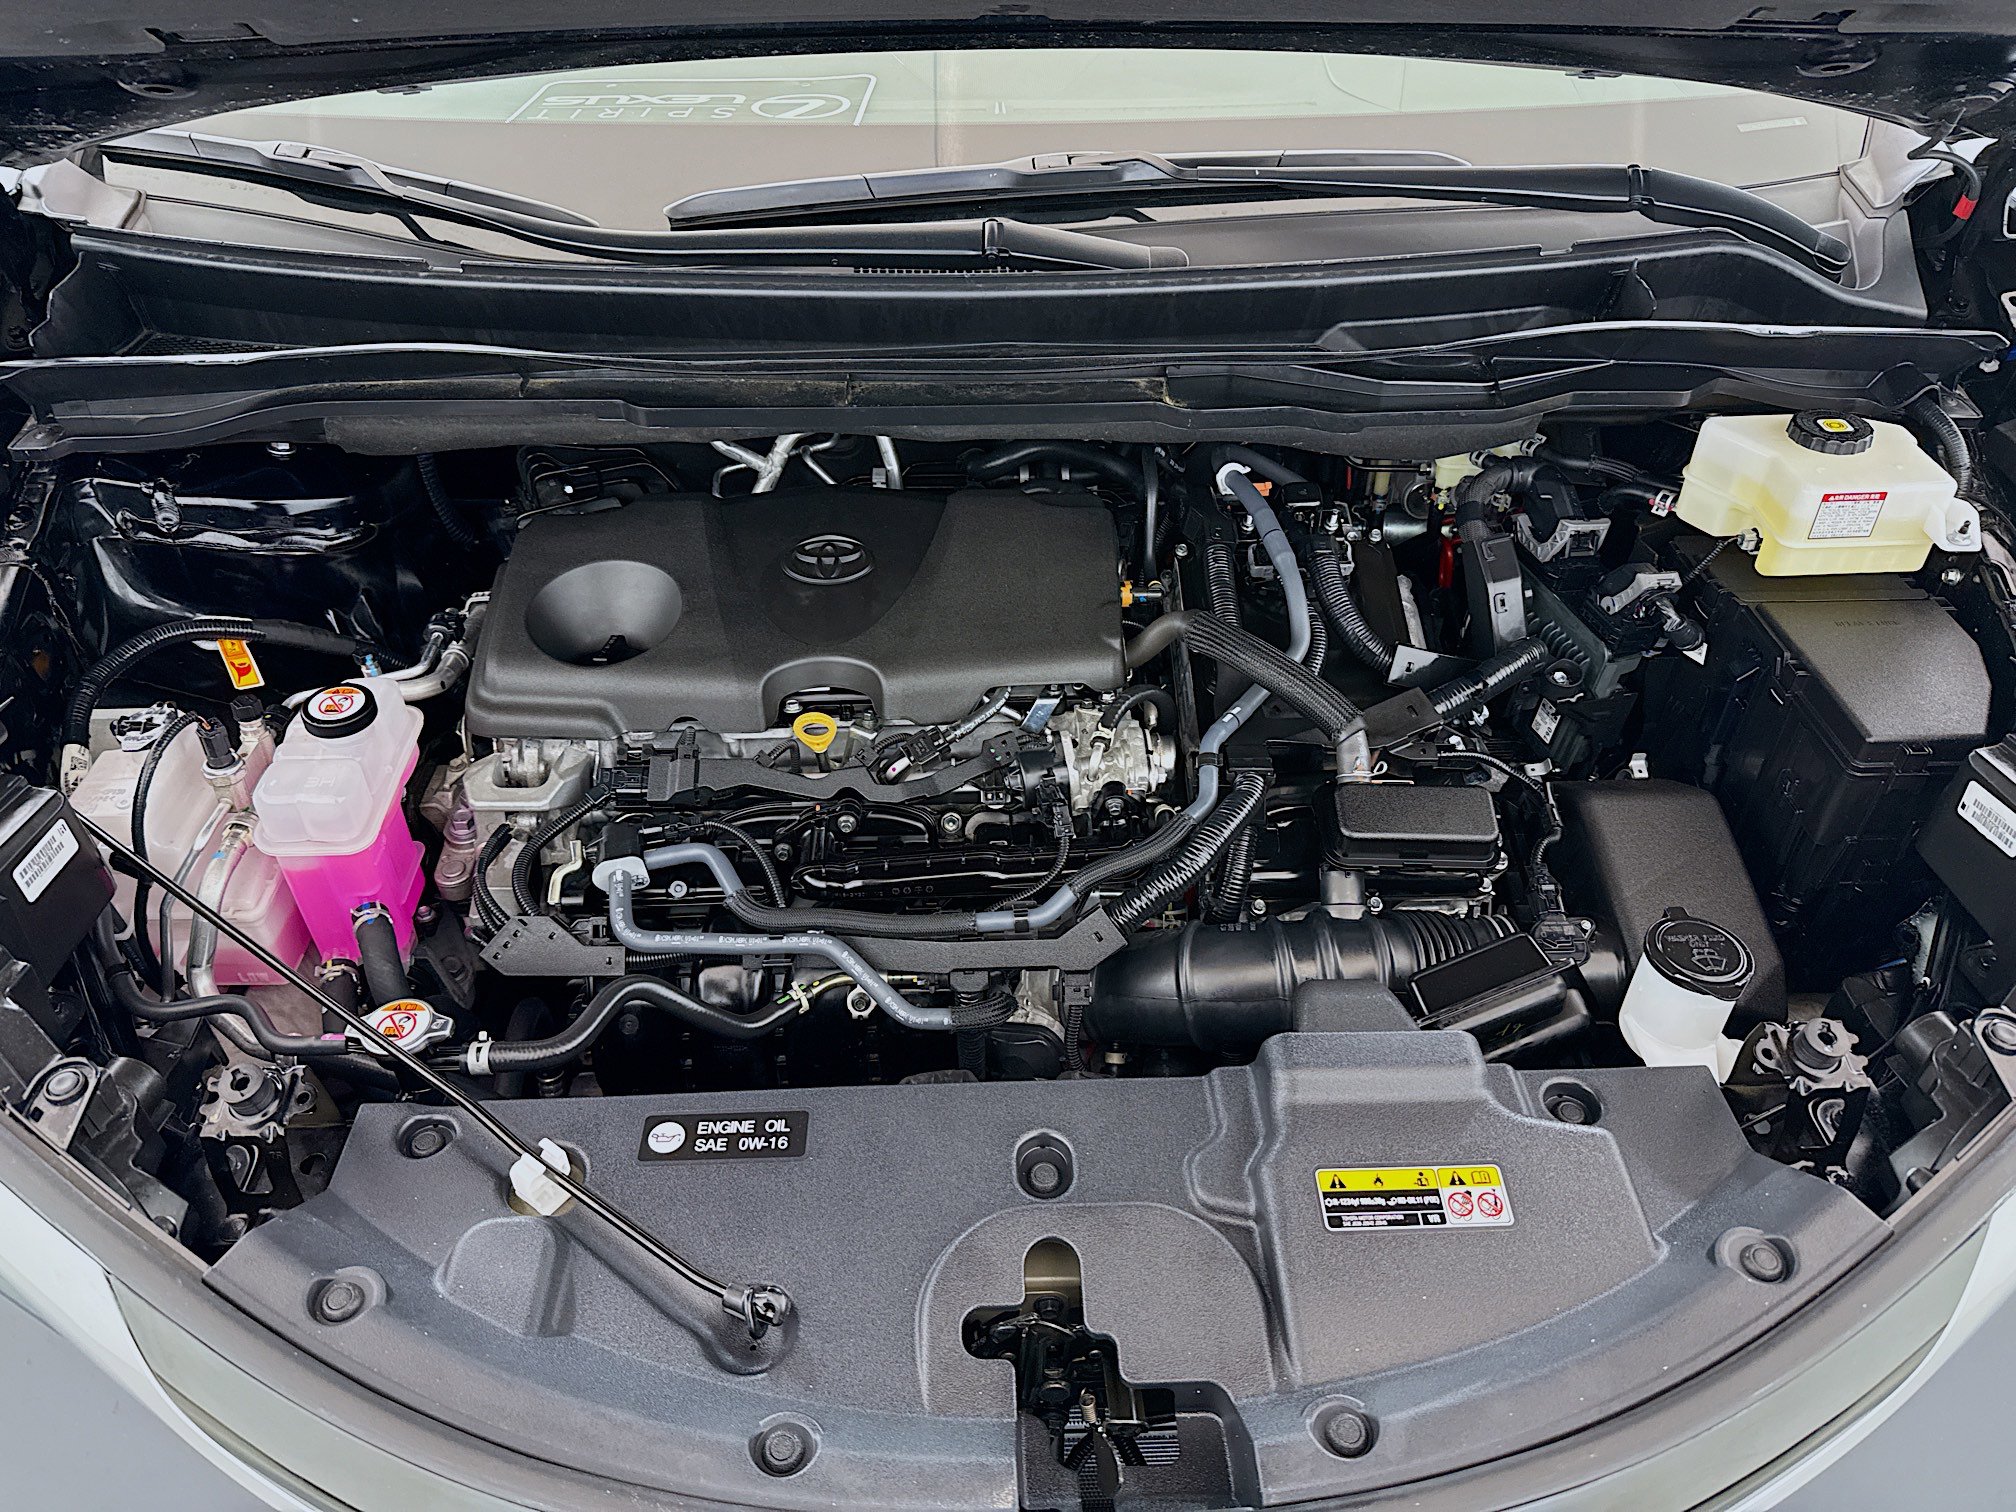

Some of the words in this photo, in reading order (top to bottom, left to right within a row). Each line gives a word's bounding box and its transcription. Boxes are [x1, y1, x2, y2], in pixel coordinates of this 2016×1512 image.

[543, 94, 746, 106] LEXUS
[527, 107, 738, 119] SPIRIT
[696, 1119, 756, 1135] ENGINE
[764, 1119, 791, 1133] OIL
[693, 1137, 729, 1153] SAE
[738, 1136, 789, 1151] 0W-16
